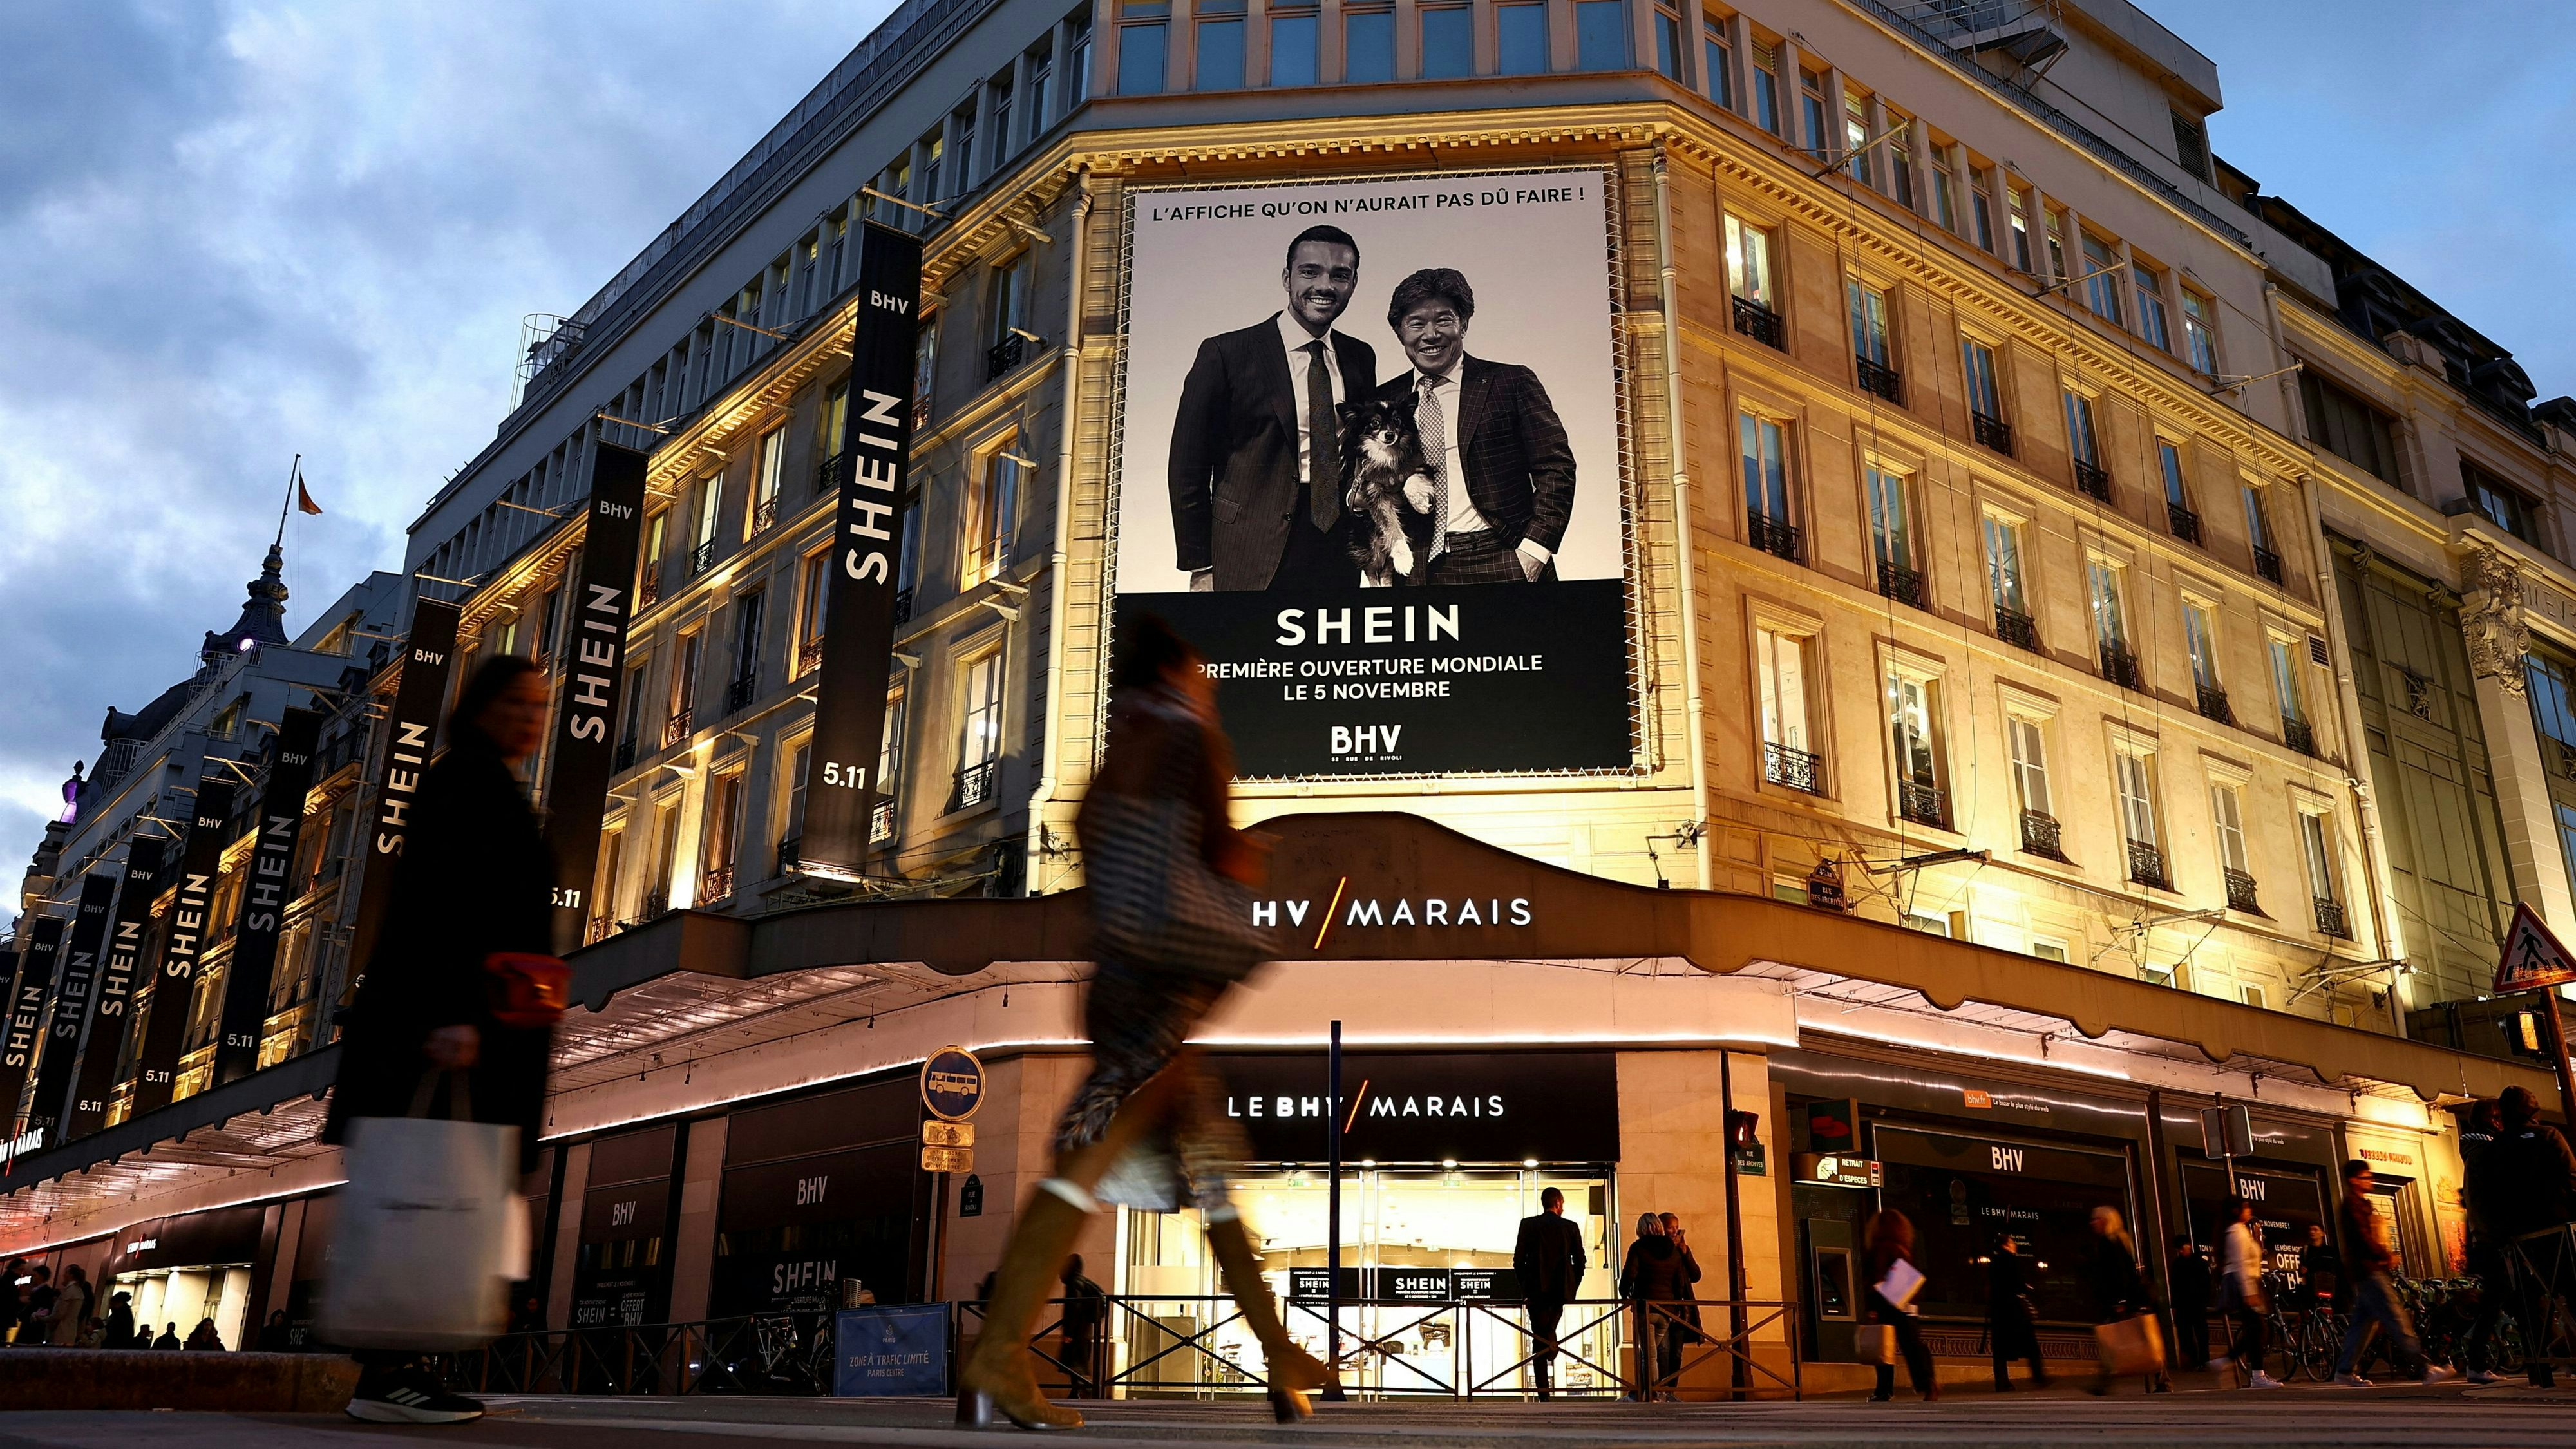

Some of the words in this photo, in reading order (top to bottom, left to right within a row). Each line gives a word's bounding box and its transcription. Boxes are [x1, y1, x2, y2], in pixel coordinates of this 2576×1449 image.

[1153, 204, 1255, 222] L'AFFICHE
[1261, 200, 1327, 218] QU'ON
[1334, 194, 1430, 213] N'AURAIT
[1436, 193, 1474, 208] PAS
[1481, 187, 1509, 205] DÛ
[1516, 187, 1572, 204] FAIRE
[871, 290, 909, 314] BHV
[845, 388, 902, 585] SHEIN
[600, 500, 633, 520] BHV
[1276, 604, 1459, 646] SHEIN
[414, 649, 444, 665] BHV
[571, 583, 622, 743] SHEIN
[1300, 658, 1425, 677] OUVERTURE
[1432, 654, 1542, 674] MONDIALE
[1284, 685, 1307, 701] LE
[1314, 684, 1326, 700] 5
[1333, 681, 1450, 699] NOVEMBRE
[1331, 724, 1402, 754] BHV
[281, 752, 308, 765] BHV
[823, 761, 866, 790] 5.11
[377, 721, 429, 857] SHEIN
[198, 817, 222, 829] BHV
[131, 869, 153, 880] BHV
[248, 815, 294, 933] SHEIN
[551, 887, 581, 908] 5.11
[1822, 886, 1833, 895] RUE
[1811, 893, 1821, 902] DES
[1822, 896, 1844, 907] ARCHIVES
[84, 904, 105, 914] BHV
[1253, 900, 1310, 927] HV
[1347, 898, 1531, 927] MARAIS
[167, 873, 210, 978] SHEIN
[35, 942, 54, 952] BHV
[101, 921, 141, 1016] SHEIN
[56, 951, 94, 1039] SHEIN
[6, 986, 43, 1067] SHEIN
[227, 1033, 254, 1048] 5.11
[146, 1070, 170, 1083] 5.11
[79, 1099, 102, 1112] 5.11
[1228, 1096, 1263, 1117] LE
[1370, 1095, 1504, 1117] MARAIS
[1967, 1094, 1986, 1104] bhv.fr
[2024, 1103, 2034, 1112] stylé
[35, 1115, 55, 1126] 5.11
[1842, 1159, 1863, 1168] RETRAIT
[1991, 1146, 2023, 1172] BHV
[1839, 1174, 1868, 1185] D'ESPECES
[797, 1175, 828, 1205] BHV
[2240, 1179, 2265, 1201] BHV
[612, 1200, 636, 1226] BHV
[1981, 1207, 1990, 1215] LE
[1991, 1208, 2005, 1217] BHV
[2011, 1211, 2040, 1220] MARAIS
[2264, 1220, 2287, 1229] NOVEMBRE
[773, 1260, 836, 1293] SHEIN
[1396, 1277, 1446, 1290] SHEIN
[1460, 1281, 1491, 1289] SHEIN
[621, 1298, 645, 1312] OFFERT
[577, 1307, 605, 1323] SHEIN
[290, 1328, 308, 1345] SHE
[850, 1356, 867, 1367] ZONE
[867, 1352, 874, 1366] À
[876, 1353, 901, 1365] TRAFIC
[903, 1350, 929, 1365] LIMITÉ
[886, 1368, 904, 1377] CENTRE
